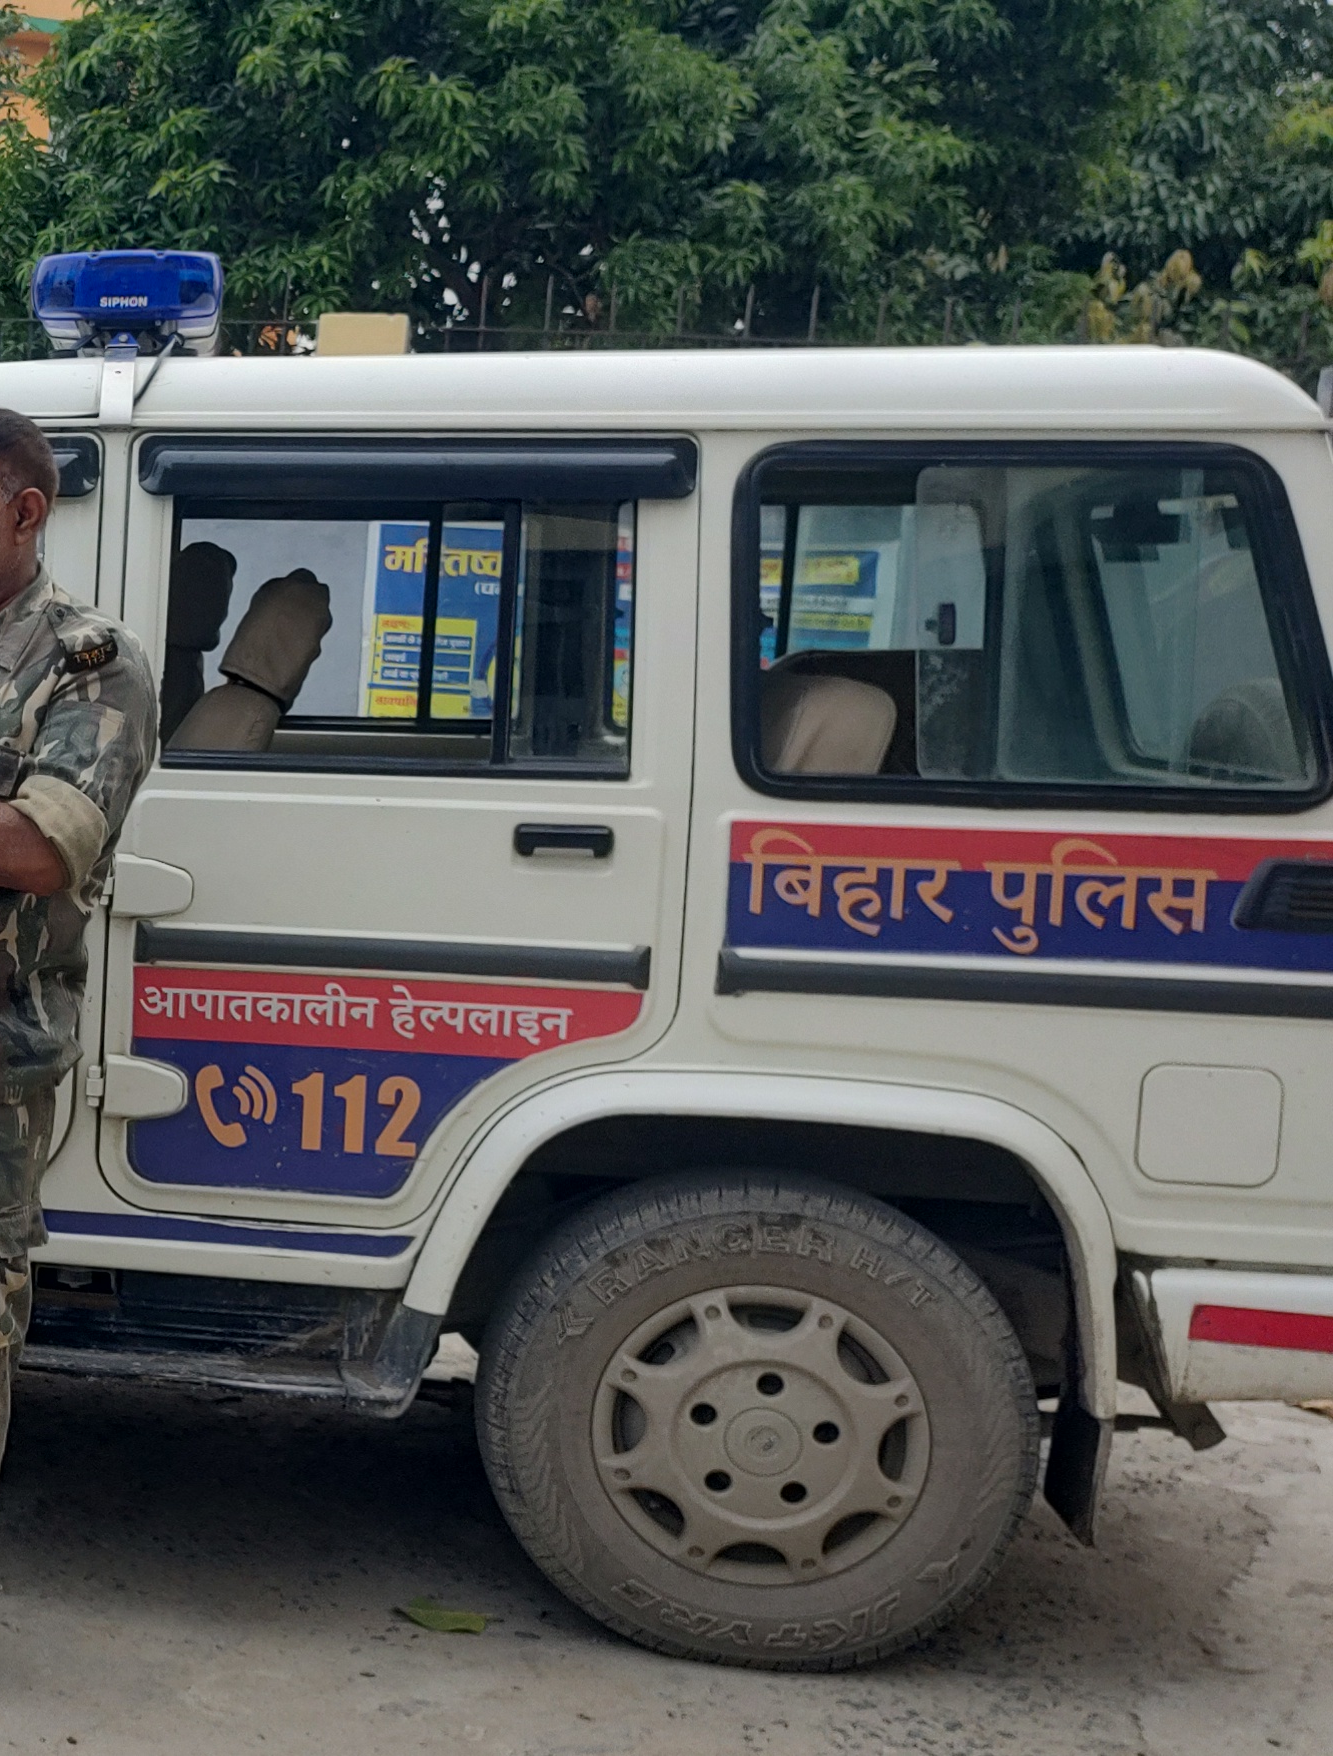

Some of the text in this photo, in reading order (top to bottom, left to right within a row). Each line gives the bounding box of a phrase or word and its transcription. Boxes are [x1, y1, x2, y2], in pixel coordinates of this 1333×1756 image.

[99, 296, 148, 308] SIPHON
[743, 828, 1218, 956] बिहार पुलिस
[139, 982, 574, 1046] आपातकालीन हेल्पलाइन
[290, 1071, 422, 1158] 112
[587, 1223, 836, 1306] RANGER
